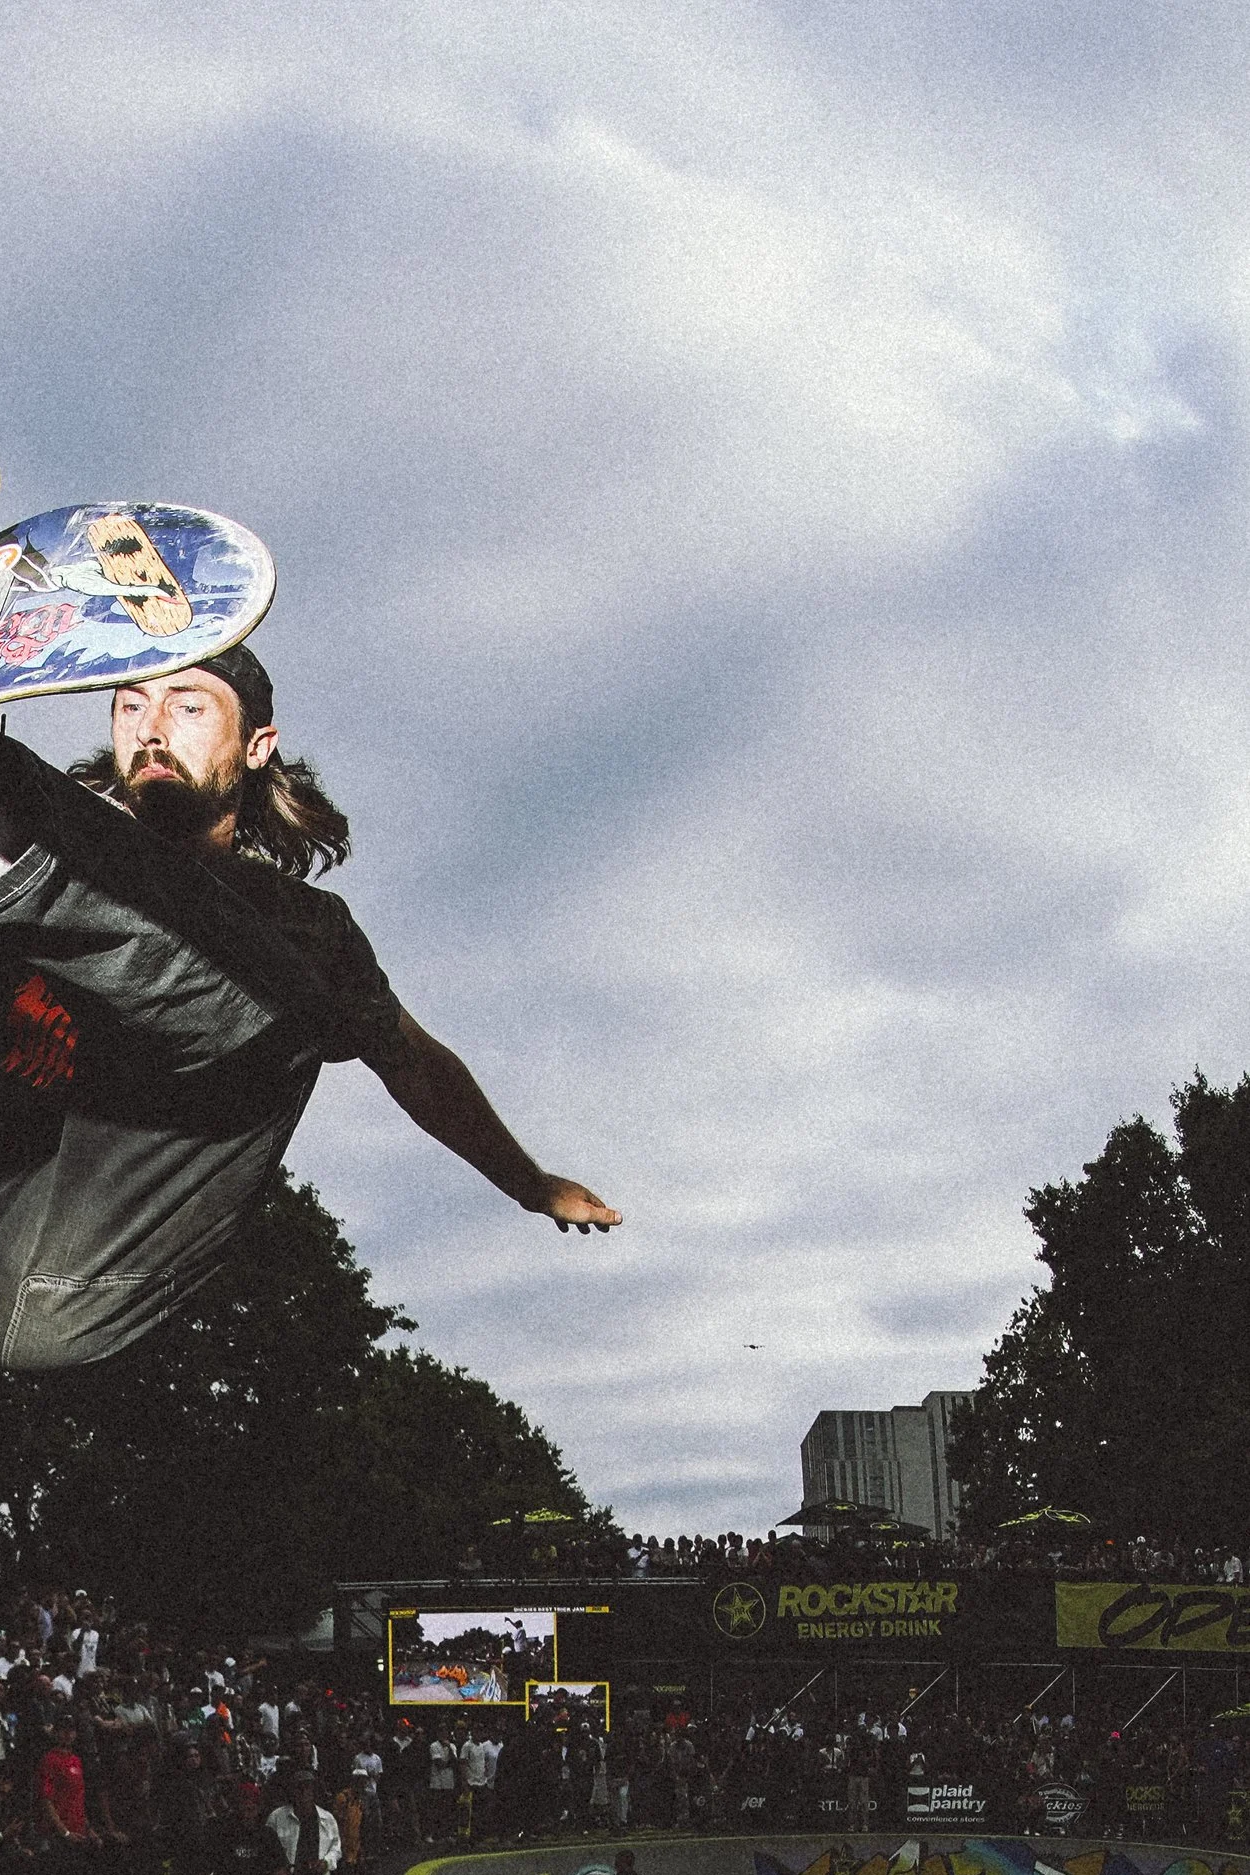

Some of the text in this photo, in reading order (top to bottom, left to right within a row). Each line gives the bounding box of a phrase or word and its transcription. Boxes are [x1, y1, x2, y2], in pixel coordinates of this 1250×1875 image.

[776, 1581, 959, 1618] ROCKSTAR
[797, 1618, 943, 1640] ENERGY DRINK
[931, 1784, 974, 1799] plaid
[929, 1799, 987, 1814] pantry
[906, 1815, 986, 1824] convenience stores
